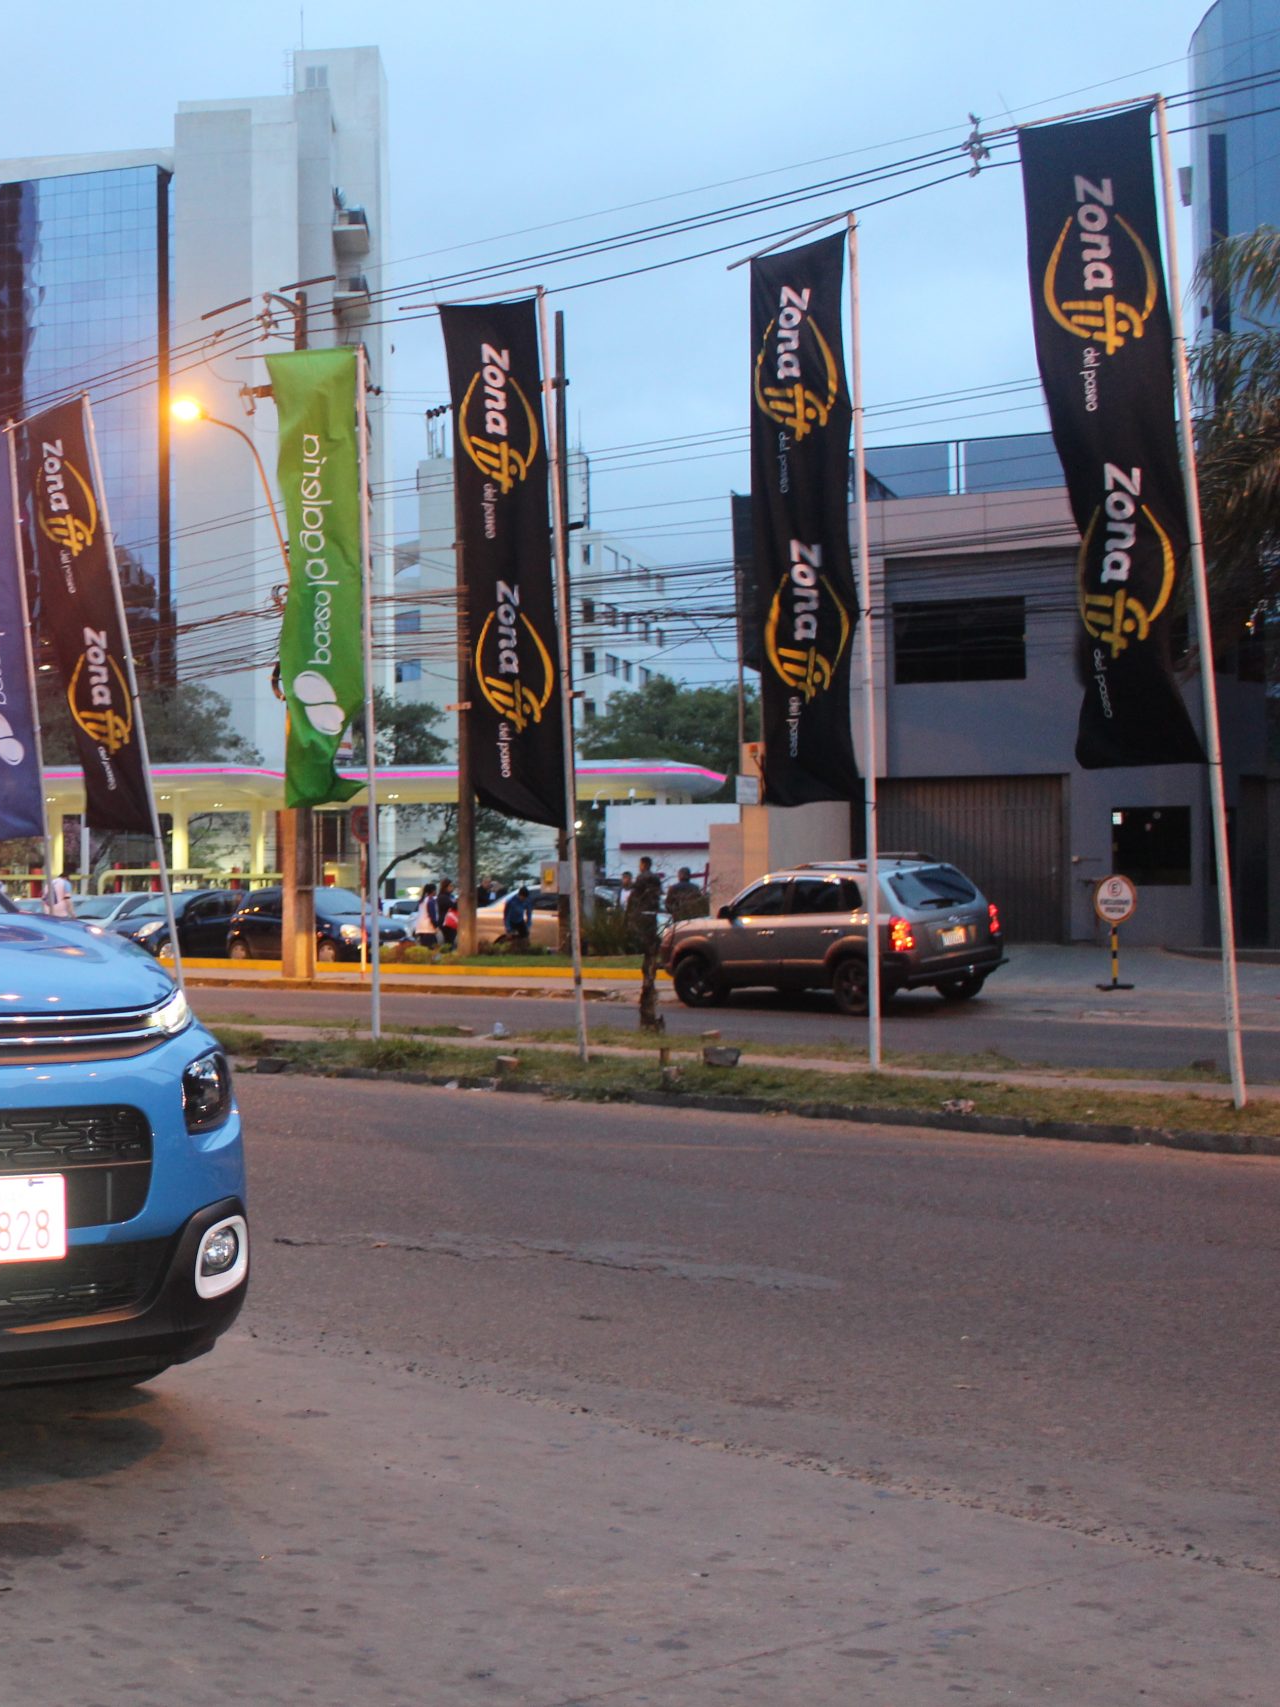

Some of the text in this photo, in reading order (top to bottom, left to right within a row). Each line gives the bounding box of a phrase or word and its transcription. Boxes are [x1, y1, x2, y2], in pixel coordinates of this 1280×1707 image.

[1073, 174, 1114, 292] Zona
[776, 286, 811, 380] Zona
[481, 343, 510, 437] Zona
[1079, 346, 1100, 413] del paseo
[42, 439, 70, 512] Zona
[777, 431, 791, 494] del paseo
[481, 482, 498, 539] del paseo
[1100, 462, 1141, 584] Zona
[495, 580, 520, 675] Zona
[789, 539, 822, 641] Zona
[83, 626, 112, 706] Zona
[1093, 648, 1113, 719] del paseo
[788, 696, 802, 717] del
[496, 722, 513, 779] del paseo
